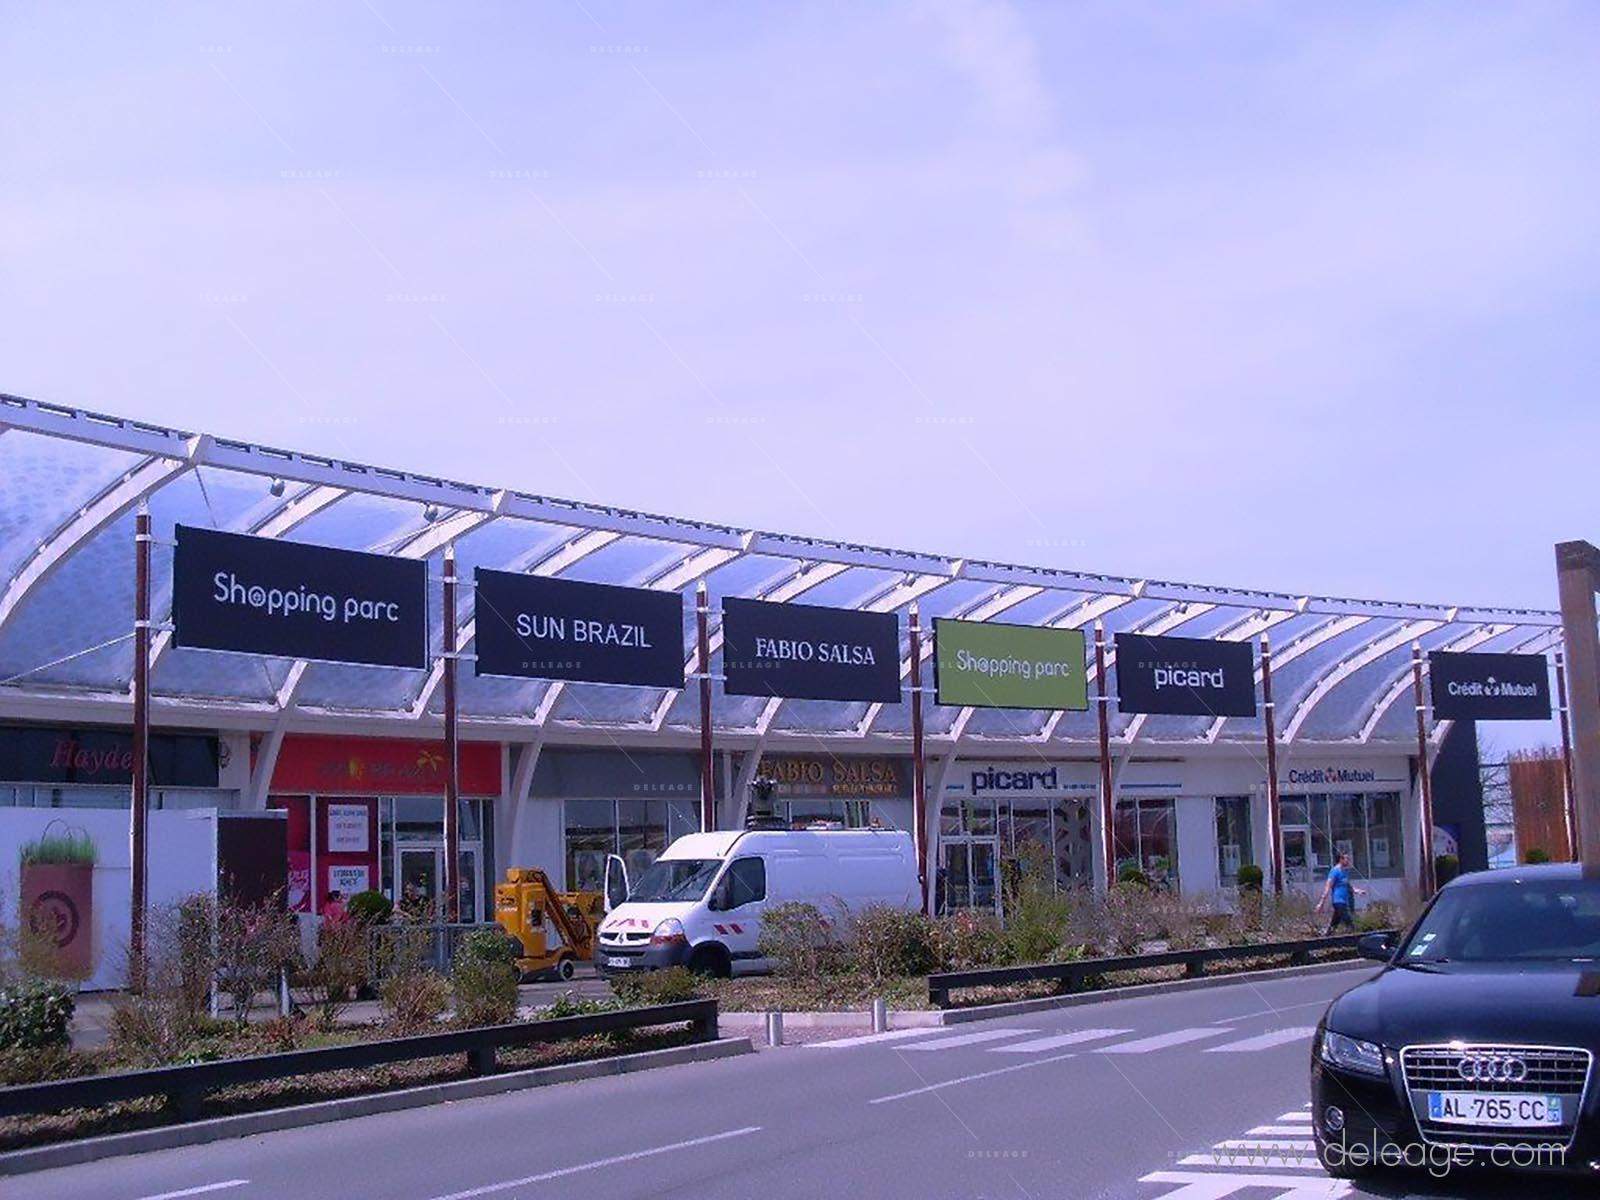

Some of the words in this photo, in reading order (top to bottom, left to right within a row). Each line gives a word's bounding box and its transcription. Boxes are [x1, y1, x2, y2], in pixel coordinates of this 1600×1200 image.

[213, 571, 337, 621] Shopping
[343, 597, 400, 623] parc
[516, 613, 565, 640] SUN
[573, 619, 652, 648] BRAZIL
[754, 637, 813, 661] FABIO
[818, 643, 876, 665] SALSA
[956, 649, 1031, 679] Shopping
[1035, 661, 1070, 680] parc
[1154, 665, 1225, 690] picard
[971, 766, 1058, 795] picard
[1337, 769, 1375, 782] Mutuel
